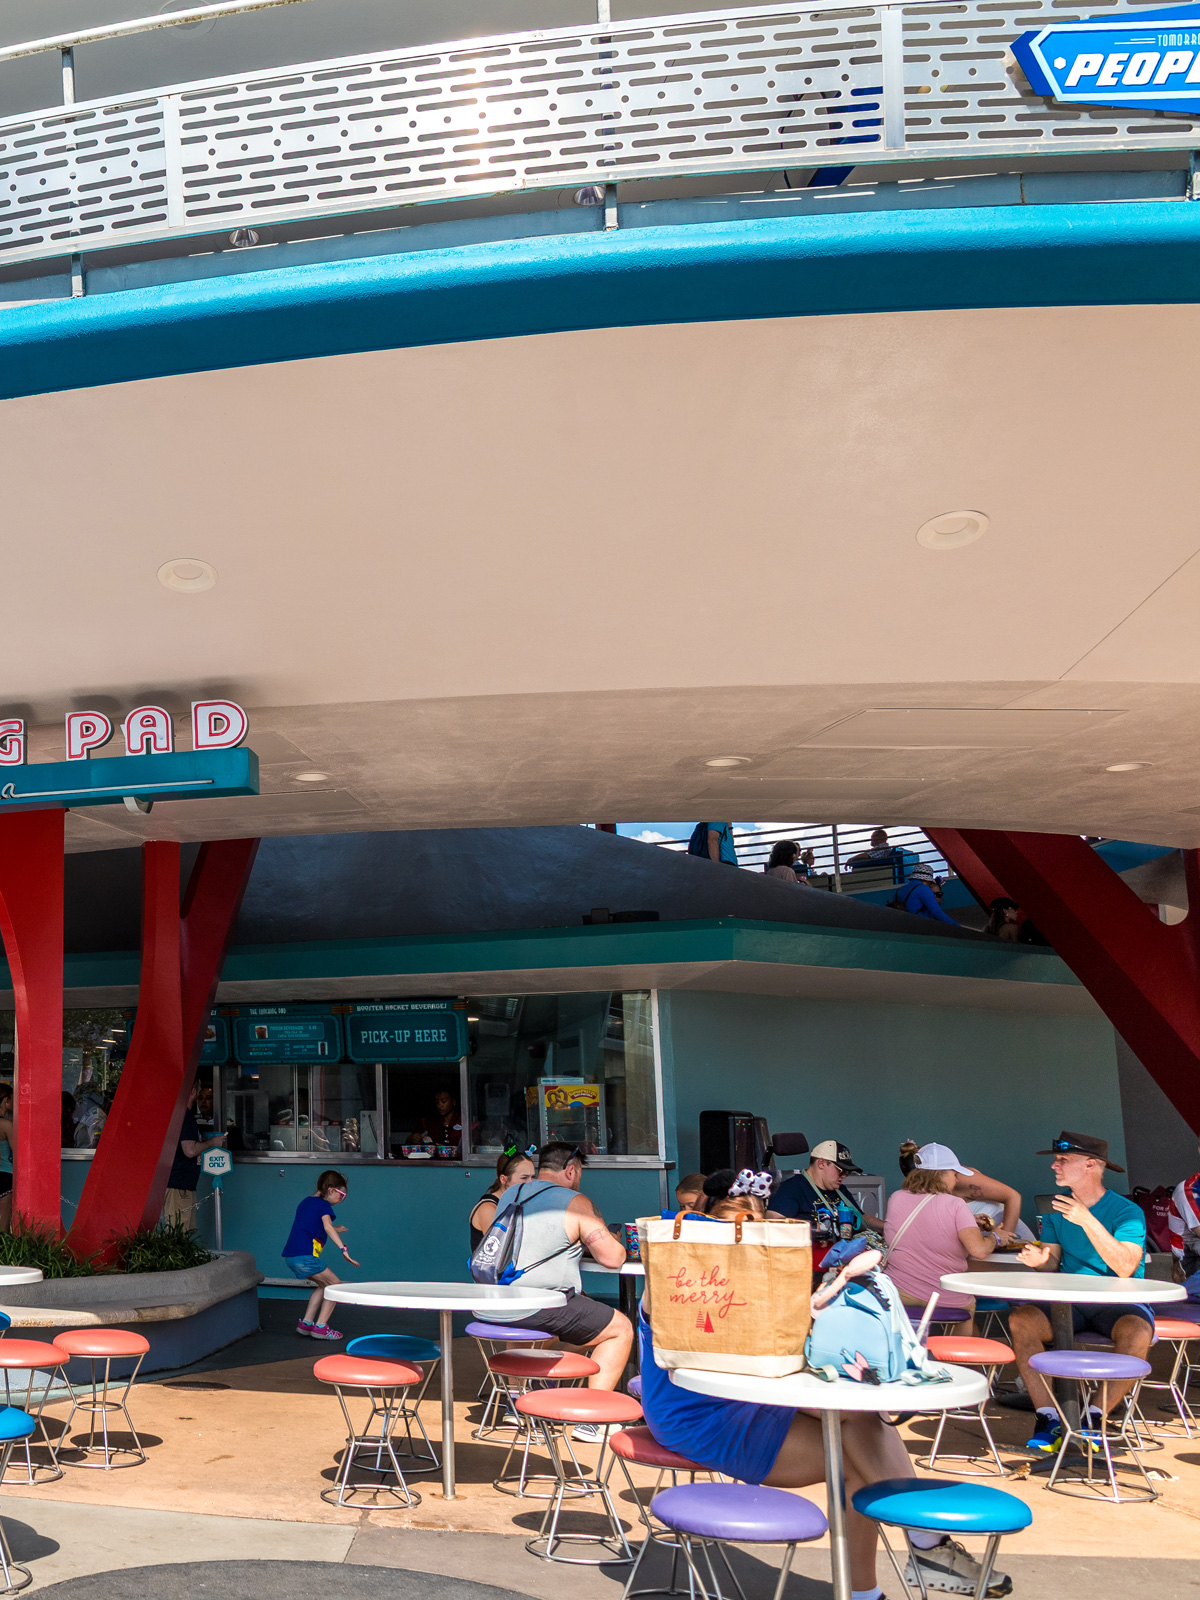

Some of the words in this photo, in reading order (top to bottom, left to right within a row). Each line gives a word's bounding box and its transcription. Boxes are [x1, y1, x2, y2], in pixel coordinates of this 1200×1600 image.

[65, 699, 249, 761] PAD
[361, 1030, 411, 1043] PICK-UP
[415, 1029, 447, 1042] HERE
[667, 1267, 697, 1288] be
[700, 1265, 730, 1287] the
[670, 1290, 747, 1318] merry
